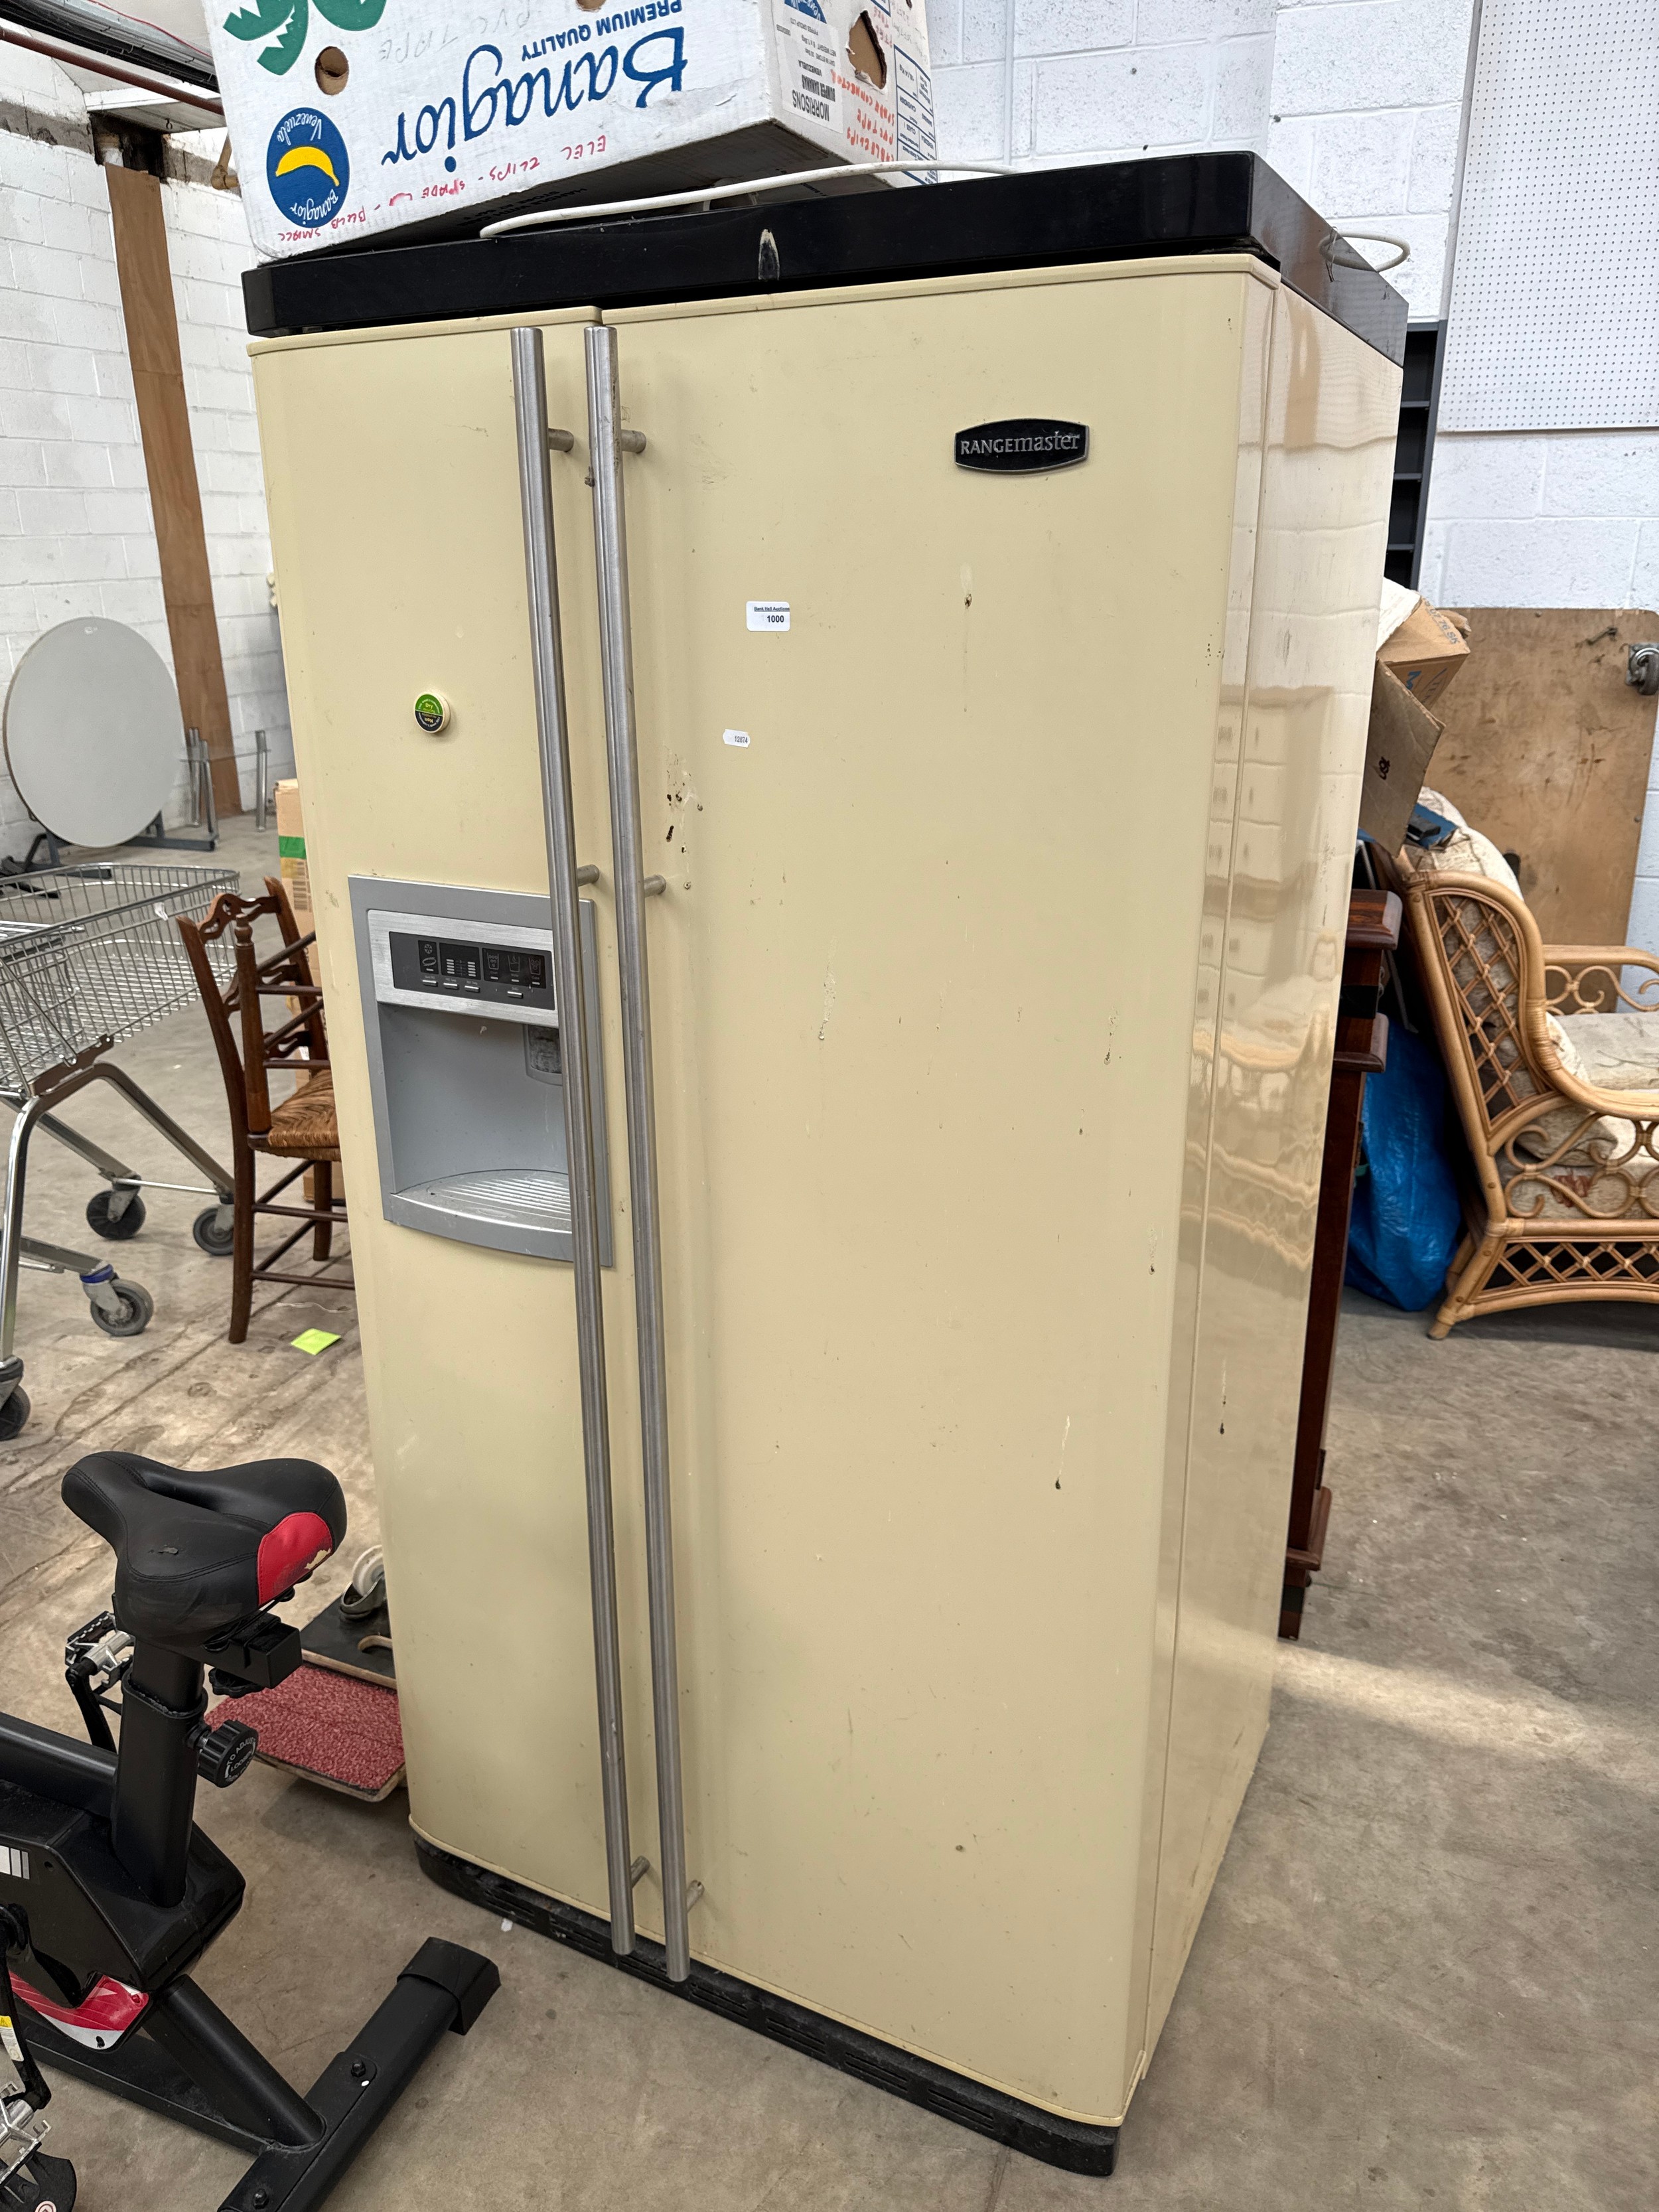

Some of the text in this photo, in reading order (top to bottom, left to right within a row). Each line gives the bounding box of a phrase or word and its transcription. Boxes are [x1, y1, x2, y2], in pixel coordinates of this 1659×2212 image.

[522, 0, 683, 62] PREMIUM QUALITY
[798, 60, 822, 76] VENEZUELA
[382, 27, 688, 173] Banagior
[802, 74, 835, 102] BUMPER BANANAS
[792, 90, 830, 121] MORRISONS
[277, 113, 322, 145] Venezuela
[560, 135, 606, 160] ELEC
[289, 189, 338, 224] Banagior
[960, 430, 1080, 455] RANGEmaster
[766, 615, 784, 623] 1000
[735, 735, 748, 744] 12874
[226, 1754, 236, 1766] TO
